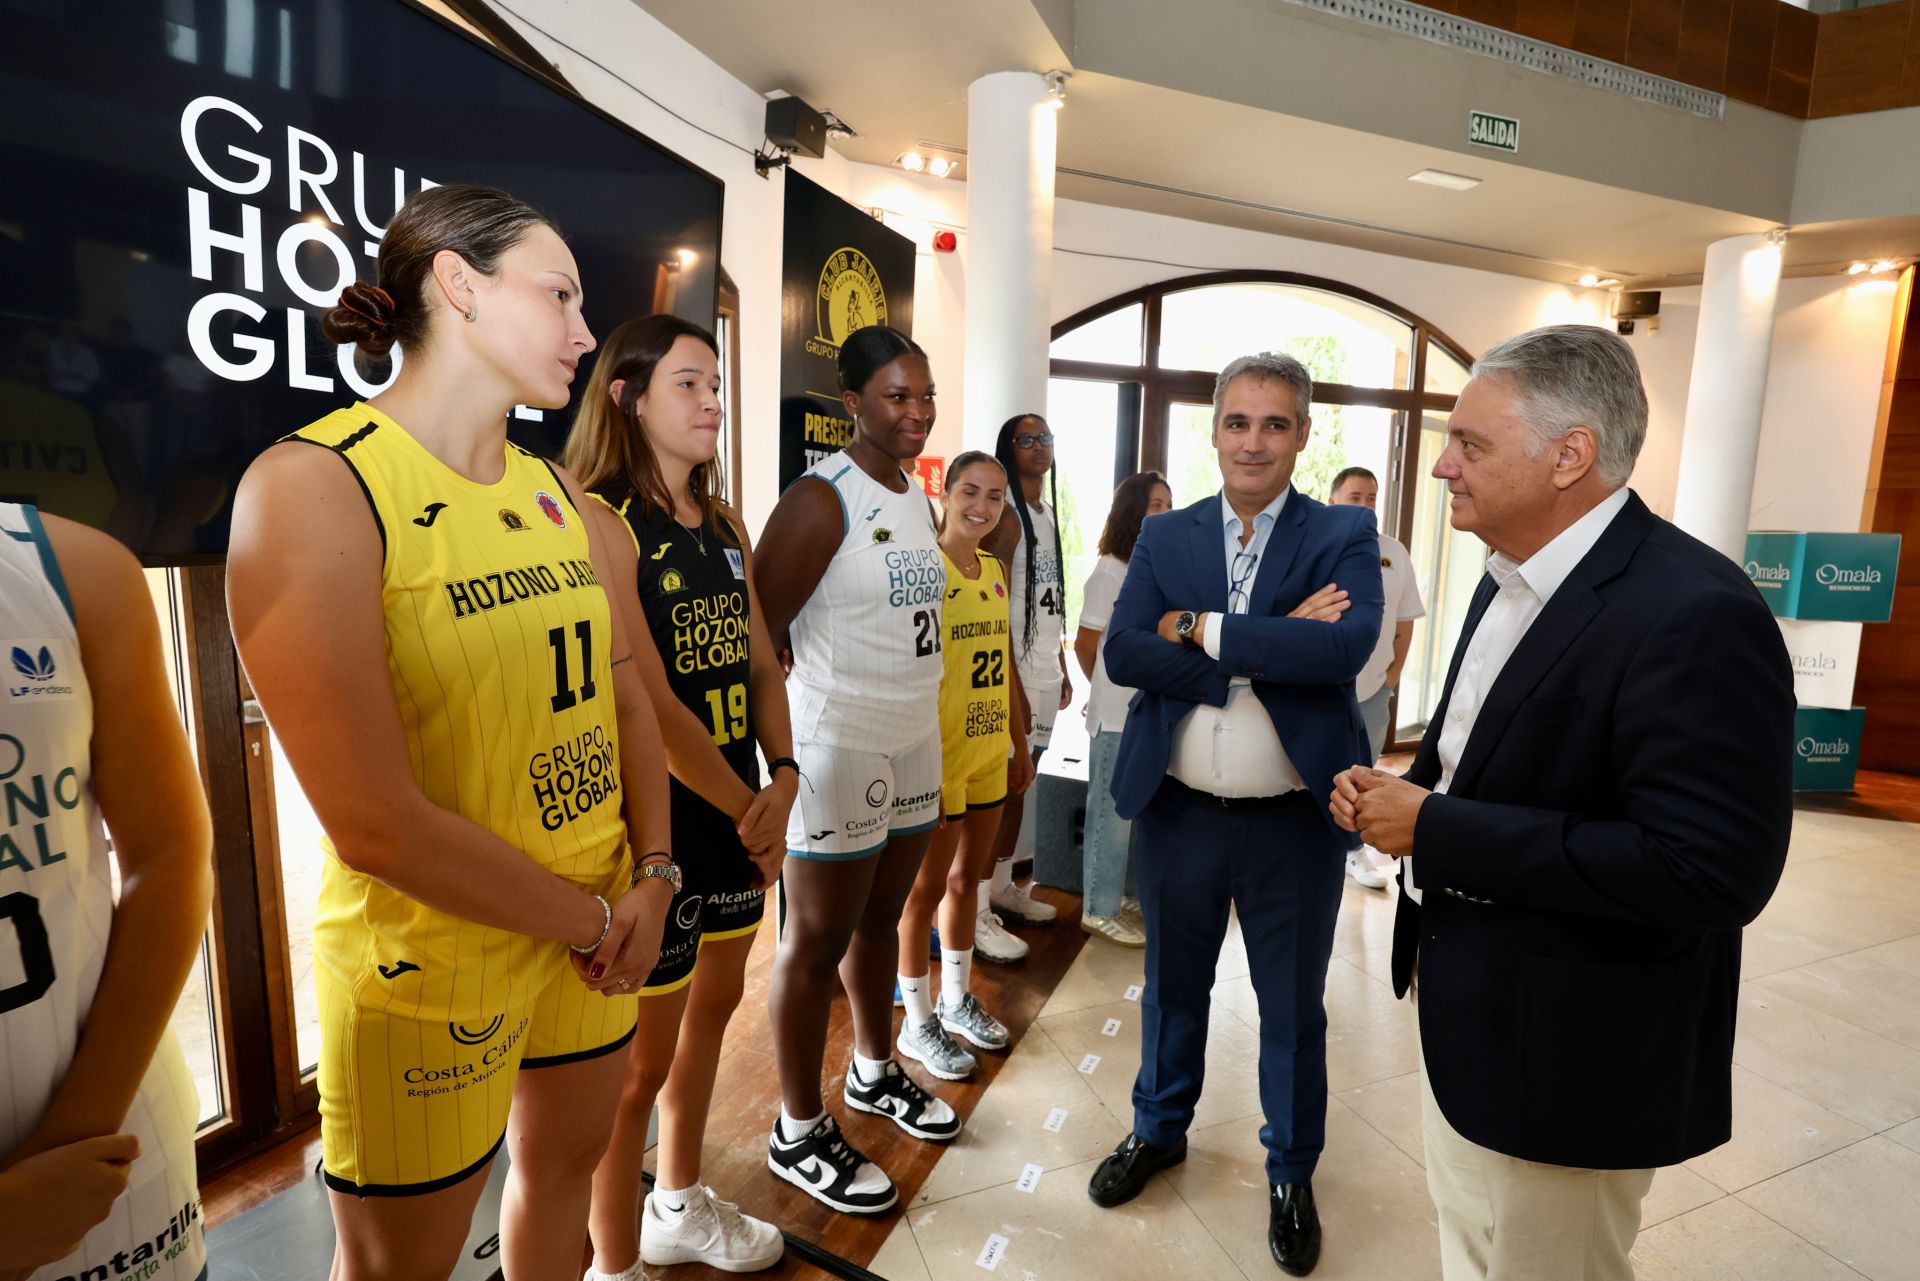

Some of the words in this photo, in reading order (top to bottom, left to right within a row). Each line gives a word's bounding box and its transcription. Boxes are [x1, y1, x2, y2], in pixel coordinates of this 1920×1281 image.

[1471, 116, 1516, 147] SALIDA
[181, 96, 444, 240] GRU
[188, 187, 380, 308] HO
[821, 253, 849, 301] CLUB
[805, 340, 833, 358] GRUPO
[885, 549, 940, 569] GRUPO
[1744, 561, 1791, 581] Omala
[1816, 563, 1881, 585] Omala
[444, 563, 561, 620] HOZONO
[672, 592, 743, 627] GRUPO
[913, 609, 942, 658] 21
[951, 621, 992, 641] HOZONO
[549, 619, 597, 714] 11
[971, 649, 1004, 689] 22
[705, 683, 748, 747] 19
[967, 699, 1002, 714] GRUPO
[965, 722, 1004, 738] GLOBAL
[1797, 737, 1850, 757] Omala
[529, 725, 604, 780] GRUPO
[541, 770, 618, 832] GLOBAL
[845, 818, 877, 831] Costa
[660, 943, 688, 959] osta
[404, 1063, 475, 1084] Costa
[482, 1017, 529, 1066] Cálida
[407, 1086, 450, 1098] Región
[453, 1082, 468, 1091] de
[472, 1061, 506, 1085] Murcia
[54, 1199, 203, 1281] ntarilla
